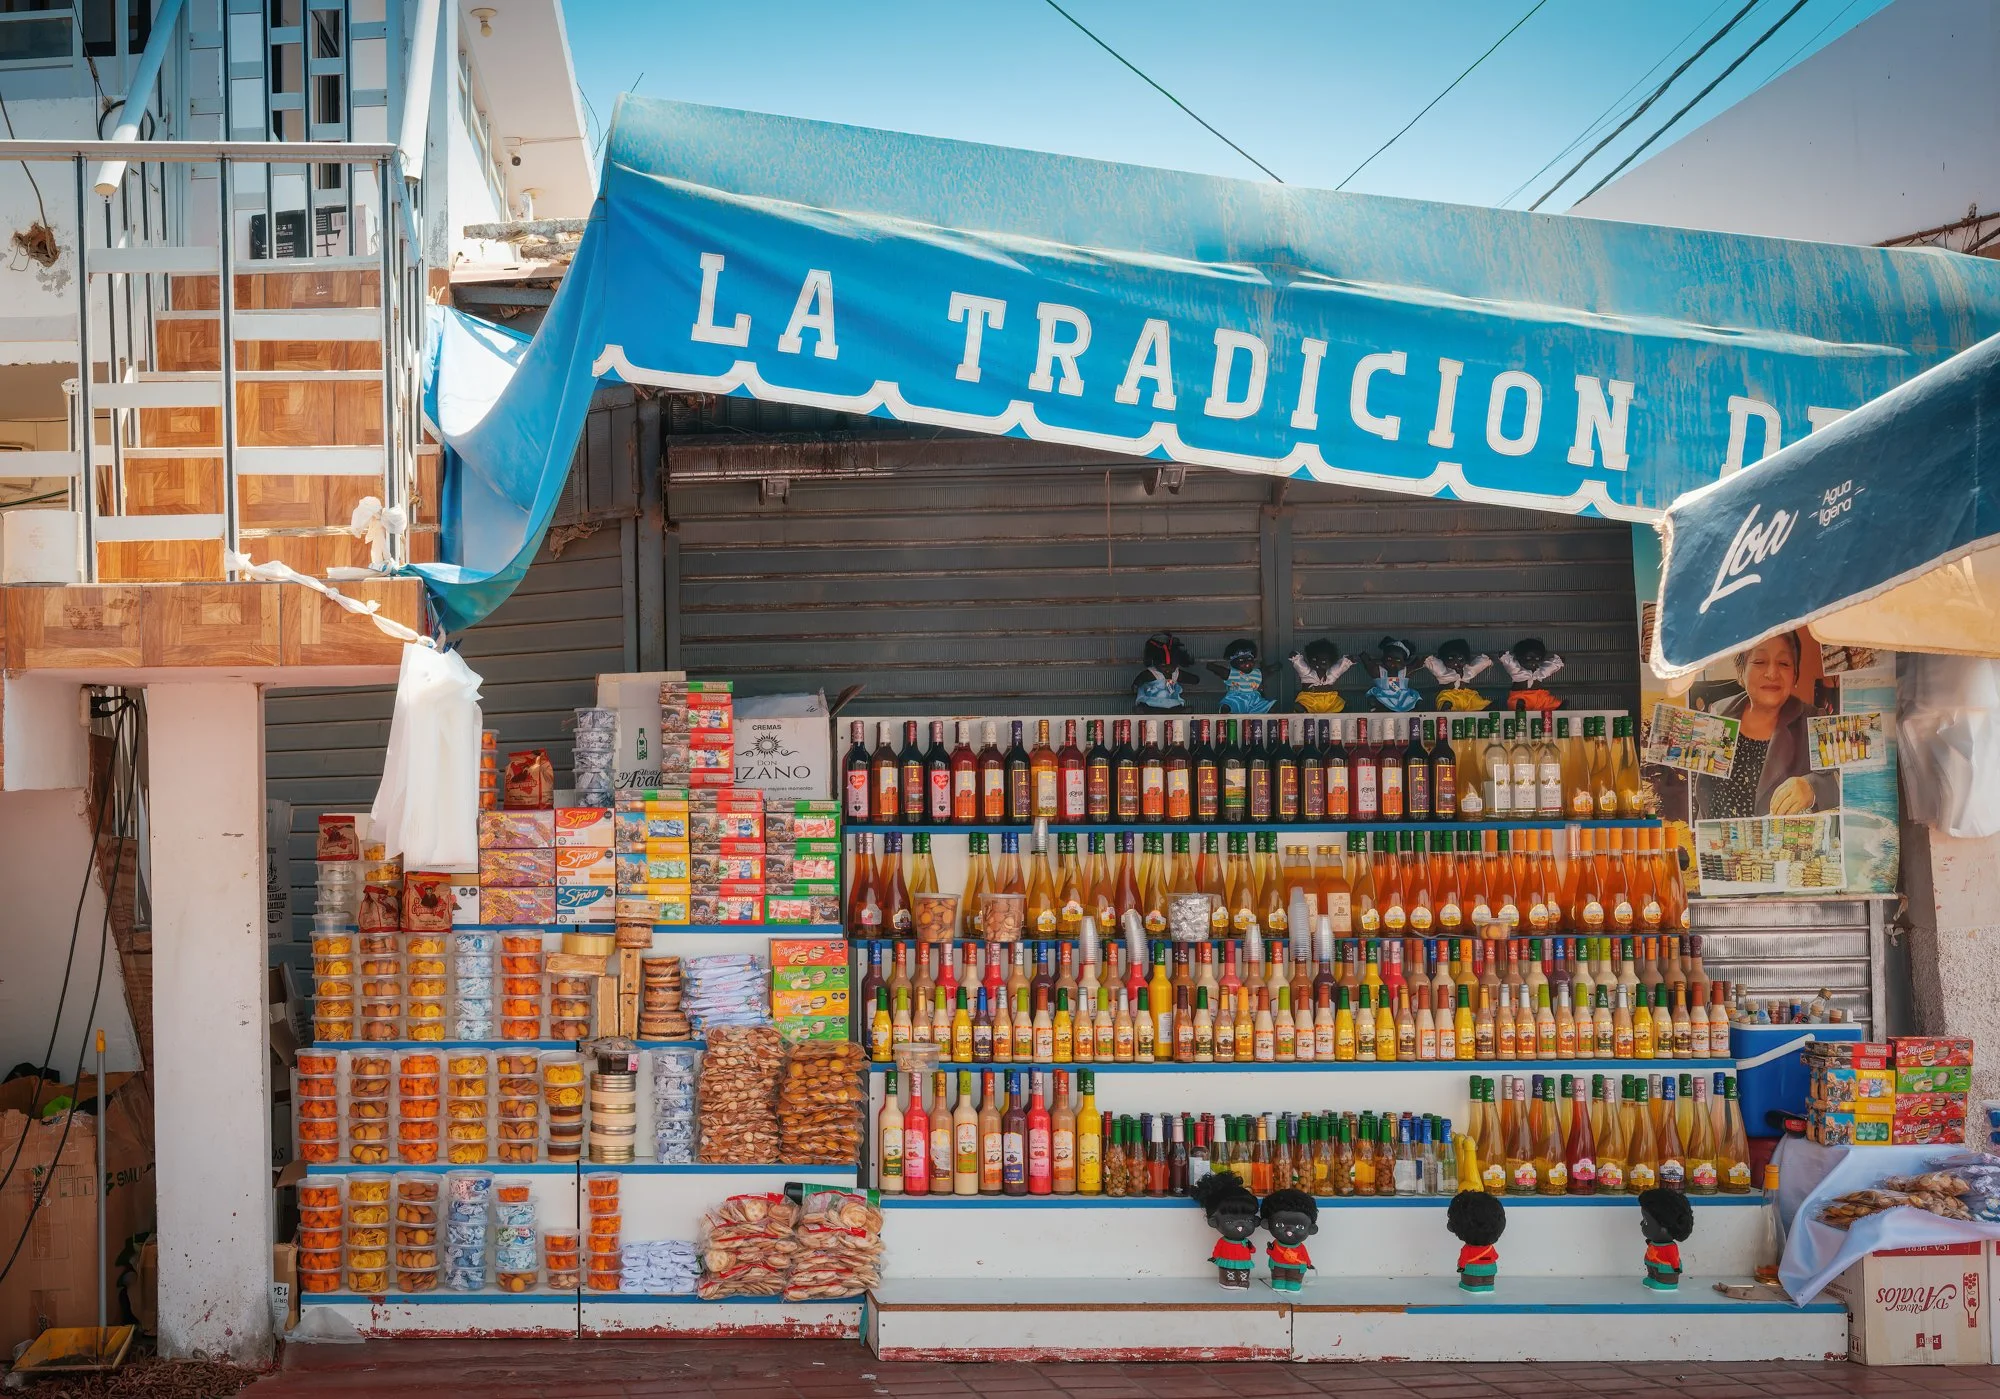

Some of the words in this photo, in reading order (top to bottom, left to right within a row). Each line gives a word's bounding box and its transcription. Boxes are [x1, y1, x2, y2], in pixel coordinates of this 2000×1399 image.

[692, 252, 839, 360] LA
[948, 291, 1634, 472] TRADICION
[1719, 395, 1851, 480] D
[1822, 479, 1852, 506] Agua
[1819, 497, 1852, 527] ligera
[614, 768, 662, 790] D'Aval
[734, 765, 811, 783] IZANO
[1876, 1284, 1957, 1311] D'Avalos
[1896, 1303, 1923, 1314] Uvas
